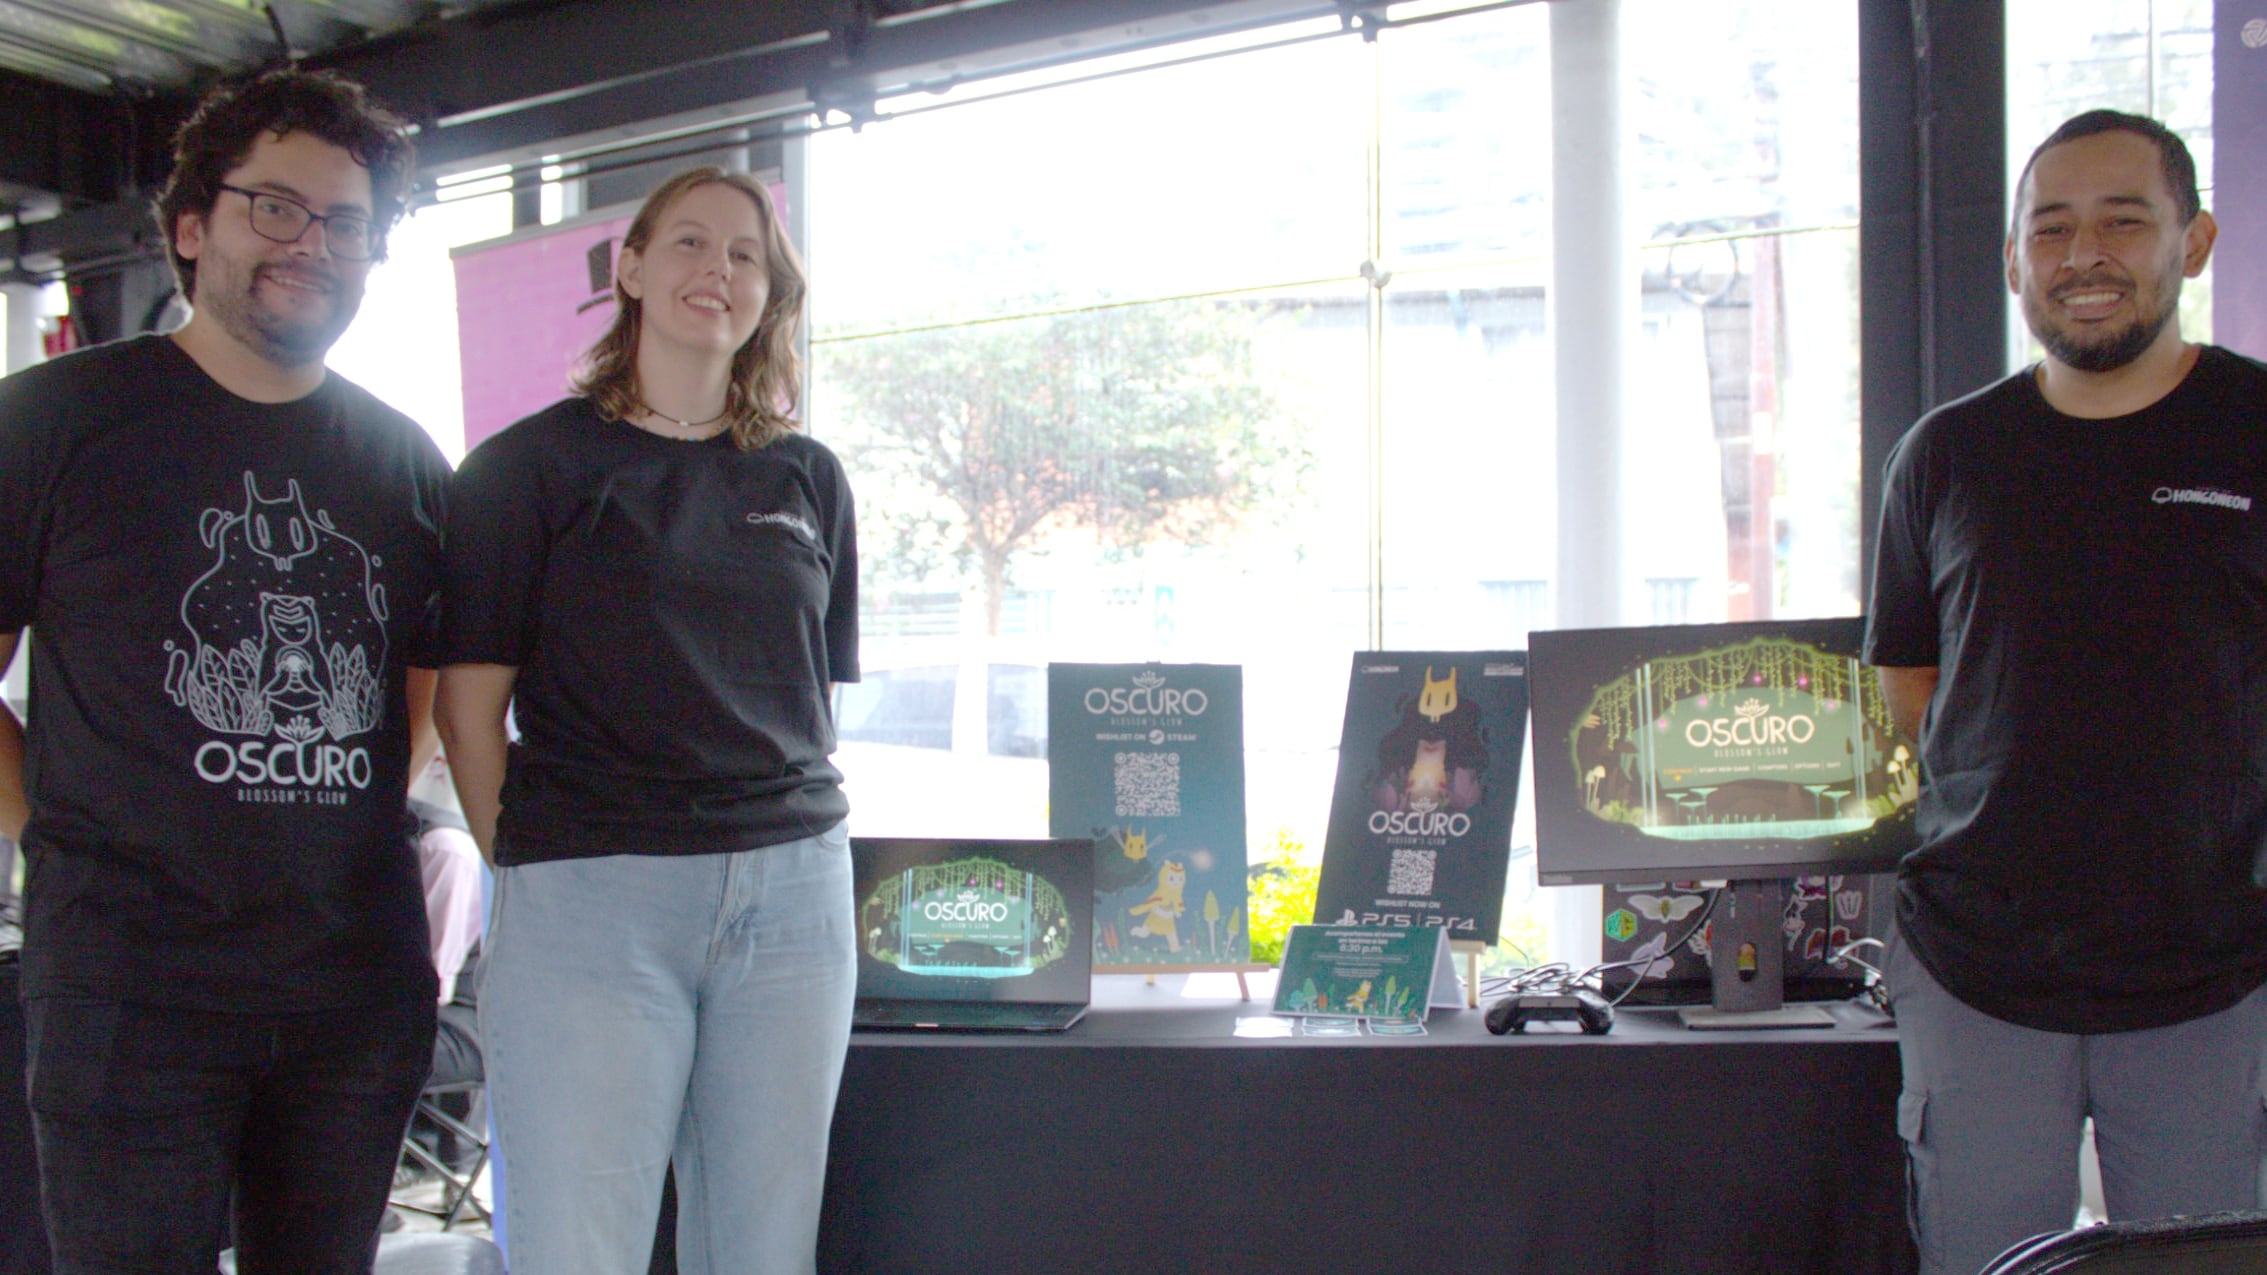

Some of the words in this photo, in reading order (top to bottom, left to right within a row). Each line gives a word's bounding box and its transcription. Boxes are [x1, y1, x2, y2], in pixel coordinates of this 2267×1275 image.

[2172, 489, 2251, 512] HONGONEON
[1084, 687, 1208, 716] OSCURO
[1133, 732, 1147, 741] ON
[1166, 733, 1198, 742] STEAM
[1685, 714, 1815, 748] OSCURO
[194, 740, 371, 789] OSCURO
[238, 788, 310, 803] BLOSSOM'S
[317, 790, 347, 806] GLOW
[1368, 810, 1471, 837] OSCURO
[924, 901, 1008, 922] OSCURO
[1361, 912, 1412, 928] PS5
[1425, 915, 1478, 931] PS4
